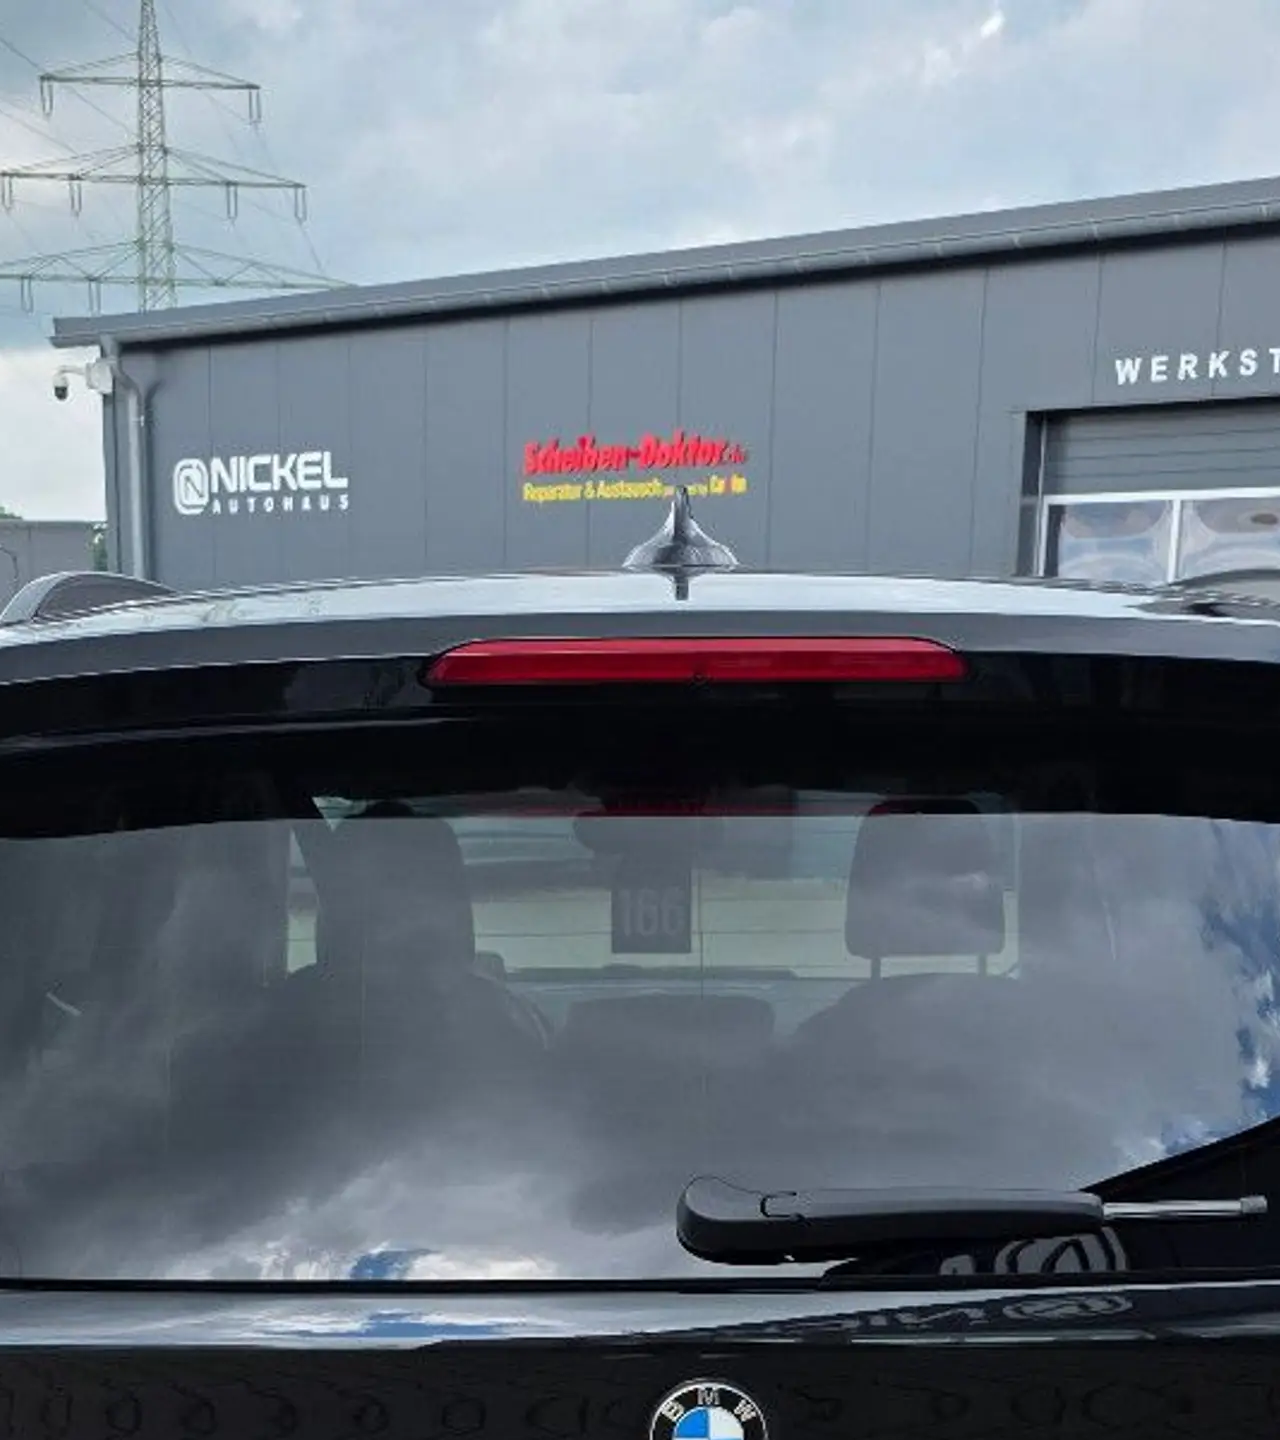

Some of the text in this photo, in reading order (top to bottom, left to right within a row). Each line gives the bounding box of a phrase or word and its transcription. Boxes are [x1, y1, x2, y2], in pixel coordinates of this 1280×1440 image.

[210, 451, 349, 494] NICKEL
[211, 493, 349, 515] AUTOHAUS
[660, 1386, 757, 1422] BMW
